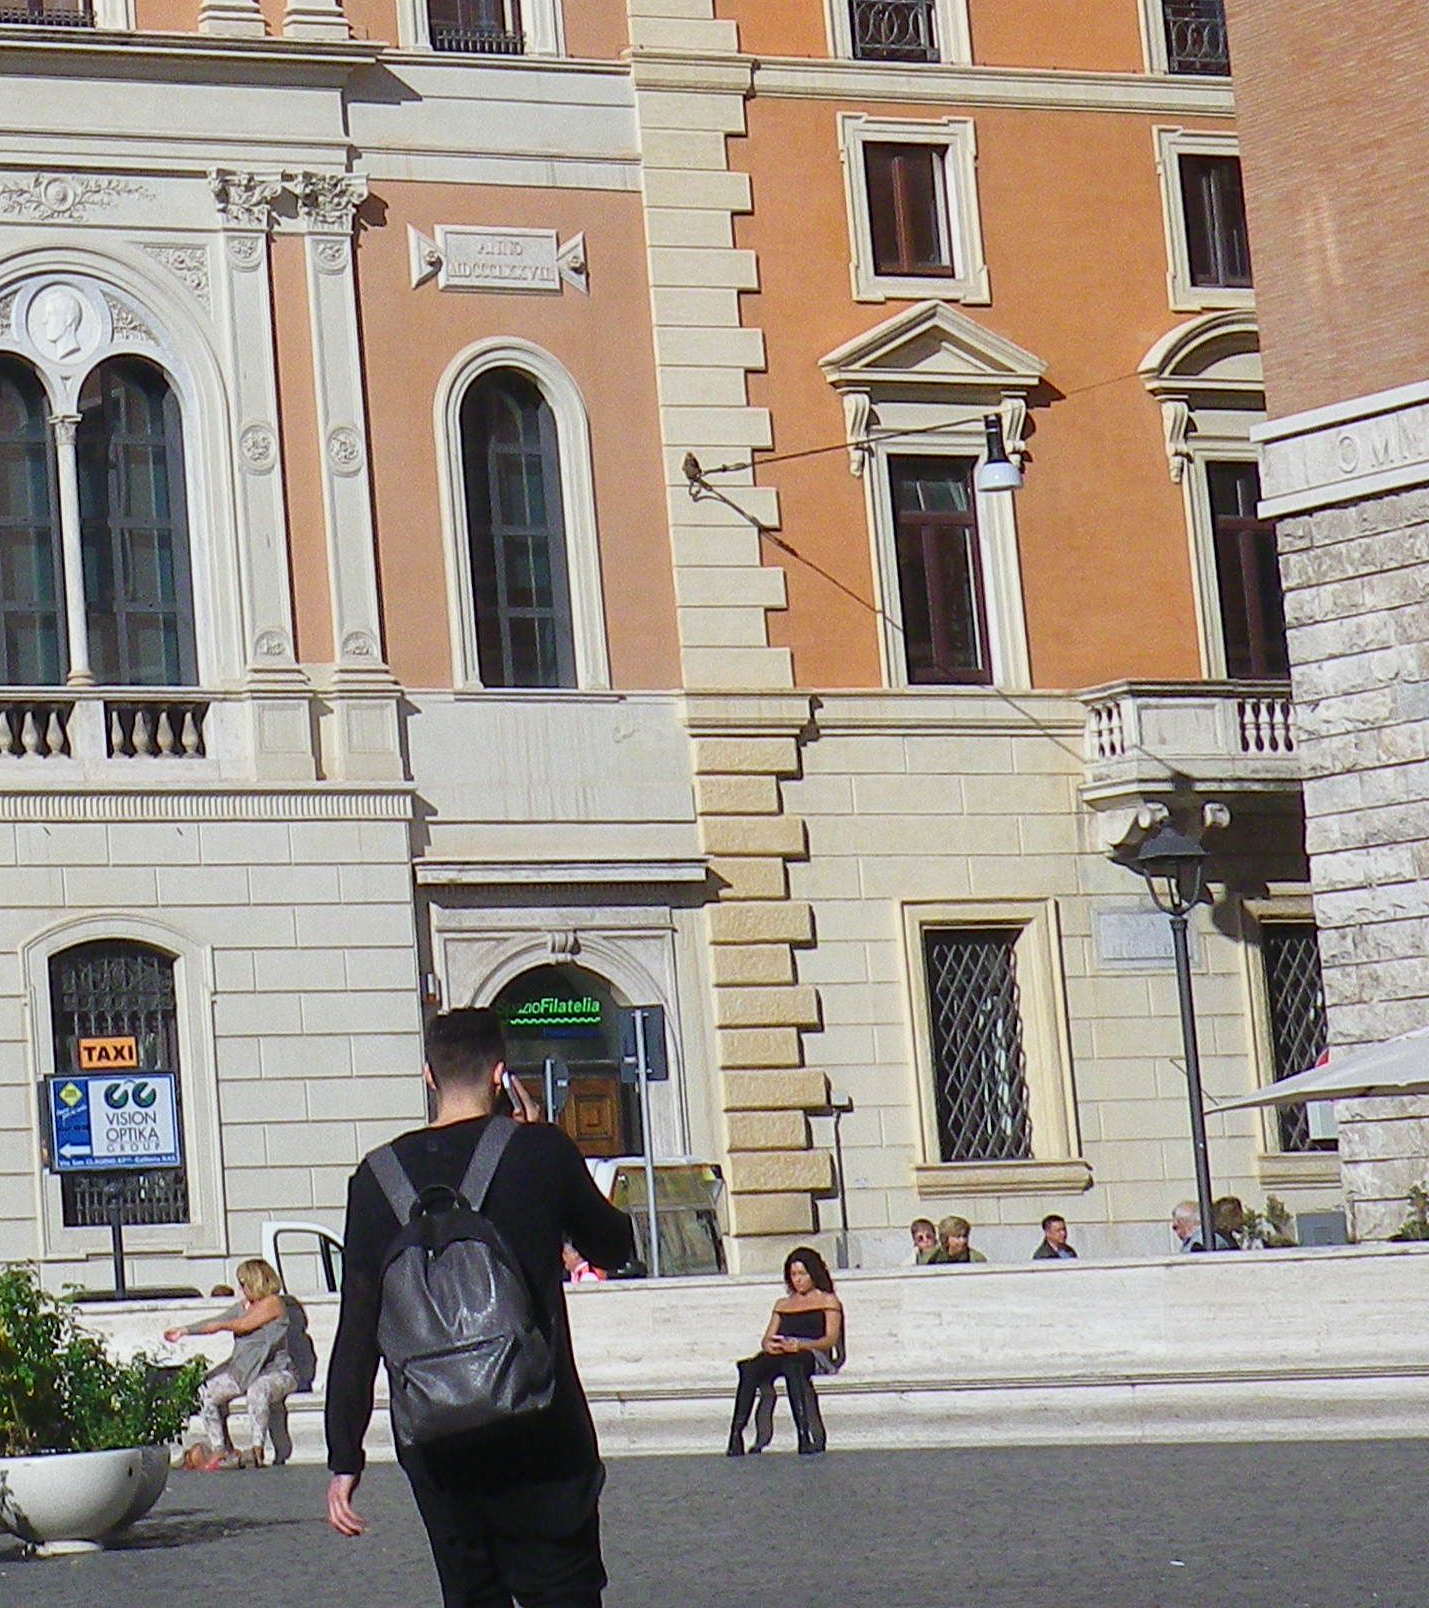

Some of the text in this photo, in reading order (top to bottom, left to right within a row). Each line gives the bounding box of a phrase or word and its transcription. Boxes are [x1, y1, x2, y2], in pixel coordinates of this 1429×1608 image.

[82, 1044, 135, 1063] TAXI
[105, 1110, 158, 1127] VISION
[105, 1127, 160, 1144] OPTIKA
[106, 1143, 160, 1153] GROUP
